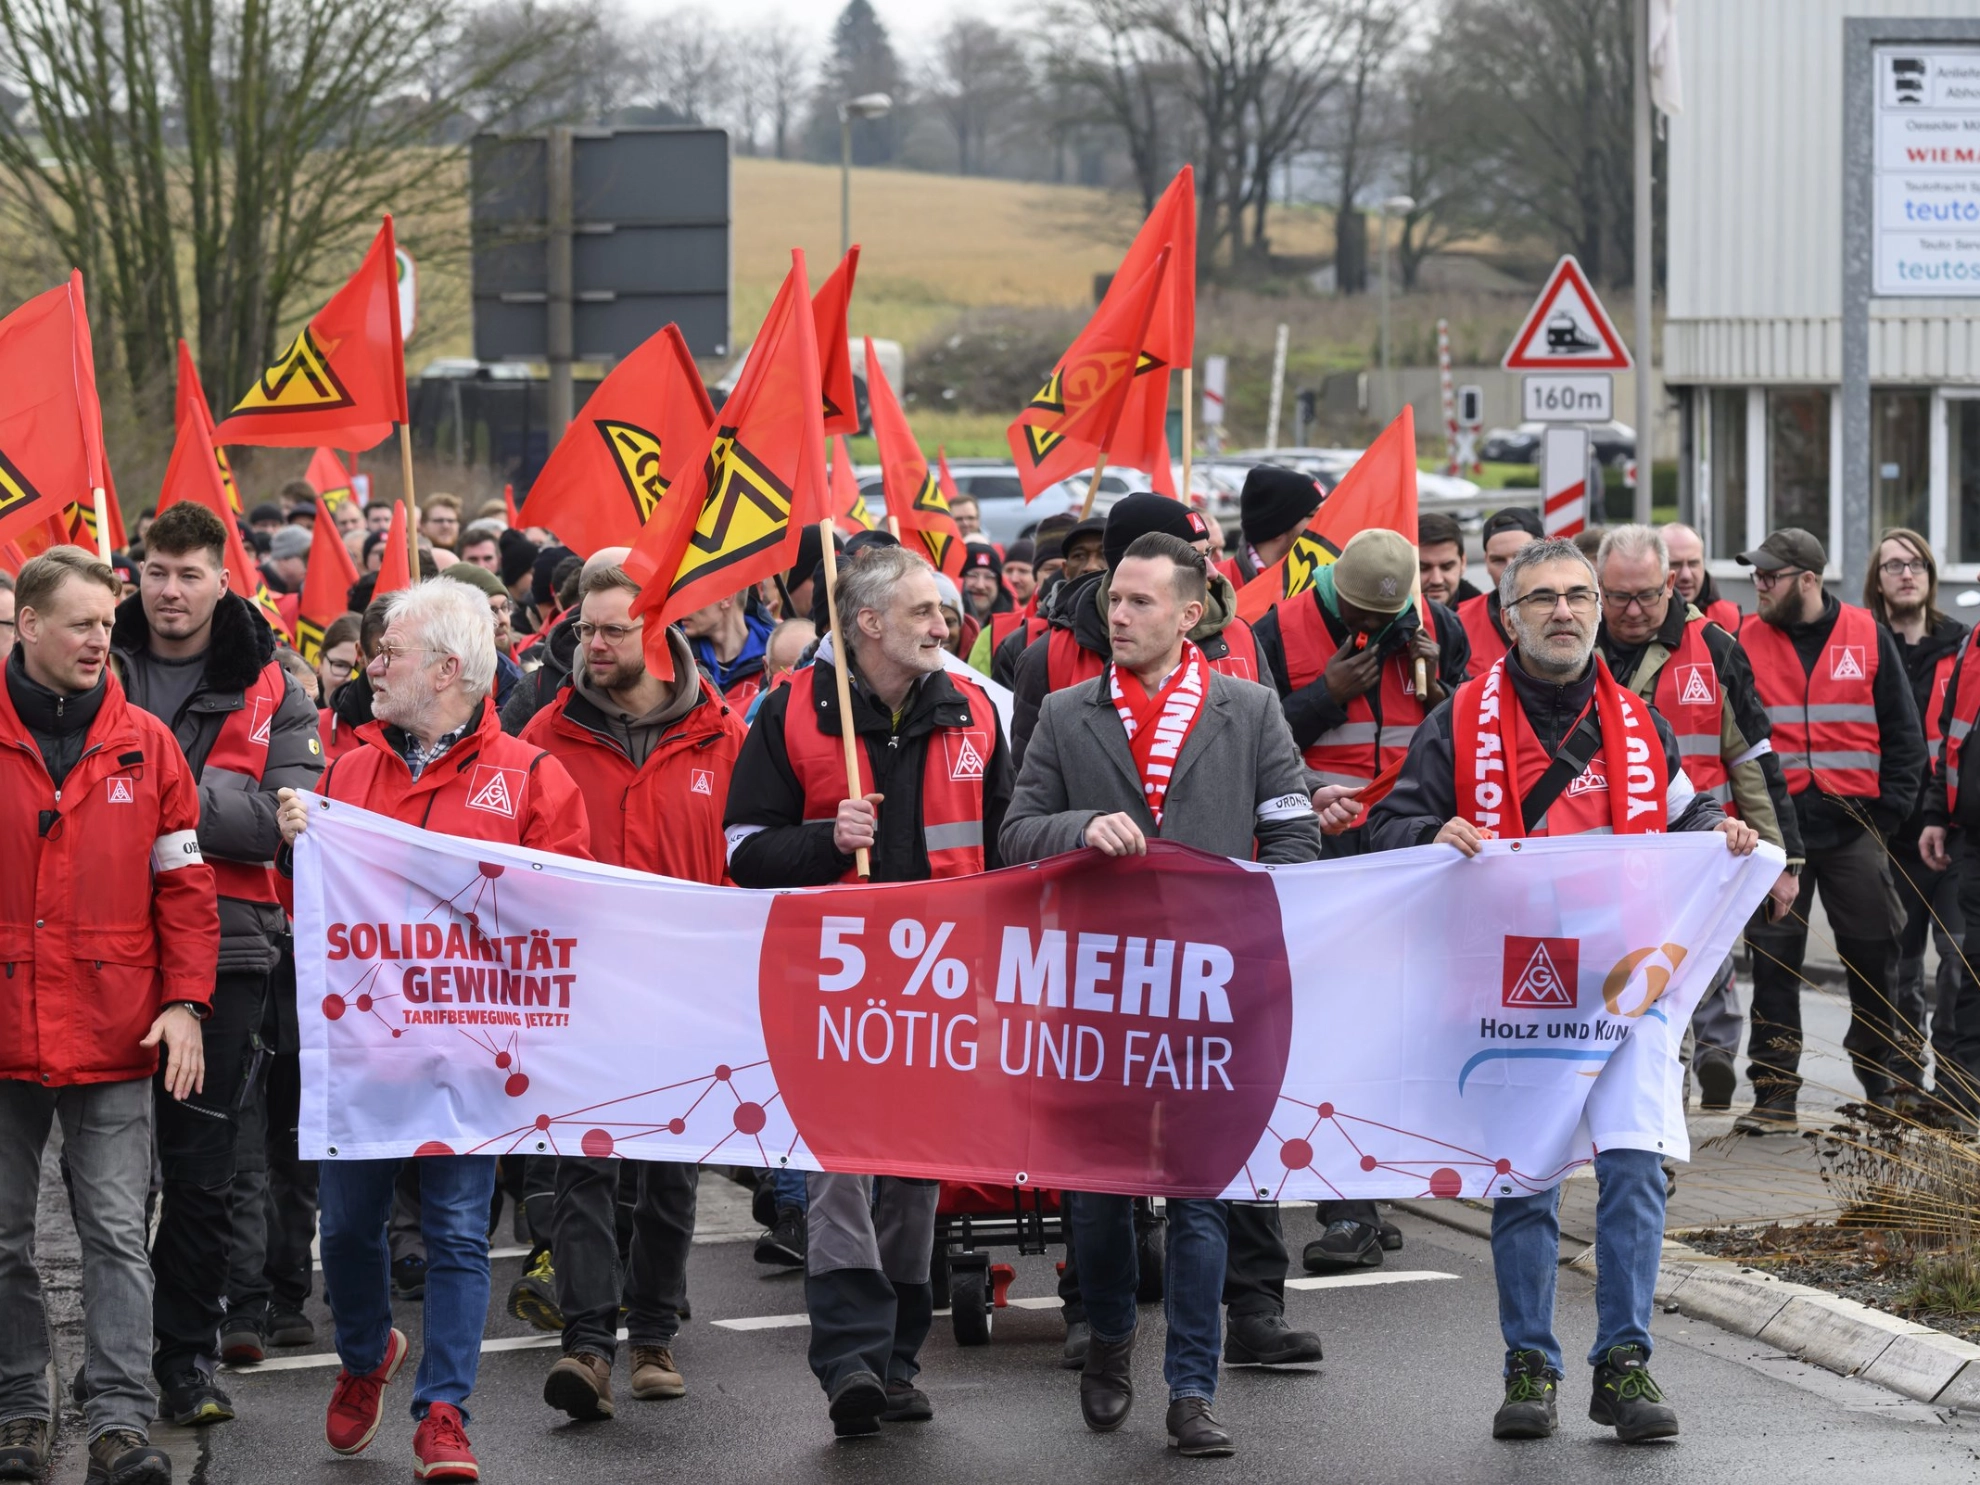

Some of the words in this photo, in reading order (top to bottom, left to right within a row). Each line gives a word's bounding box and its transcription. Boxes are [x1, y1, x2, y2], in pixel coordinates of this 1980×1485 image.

[1907, 148, 1980, 161] WIEM
[1533, 386, 1602, 409] 160m
[327, 922, 577, 971] SOLIDARITÄT
[402, 966, 576, 1008] GEWINNT
[818, 916, 866, 991] 5
[995, 926, 1234, 1022] MEHR
[403, 1010, 521, 1026] TARIFBEWEGUNG
[524, 1012, 569, 1028] JETZT!
[817, 998, 978, 1072] NÖTIG
[1000, 1018, 1105, 1081] UND
[1123, 1030, 1234, 1090] FAIR
